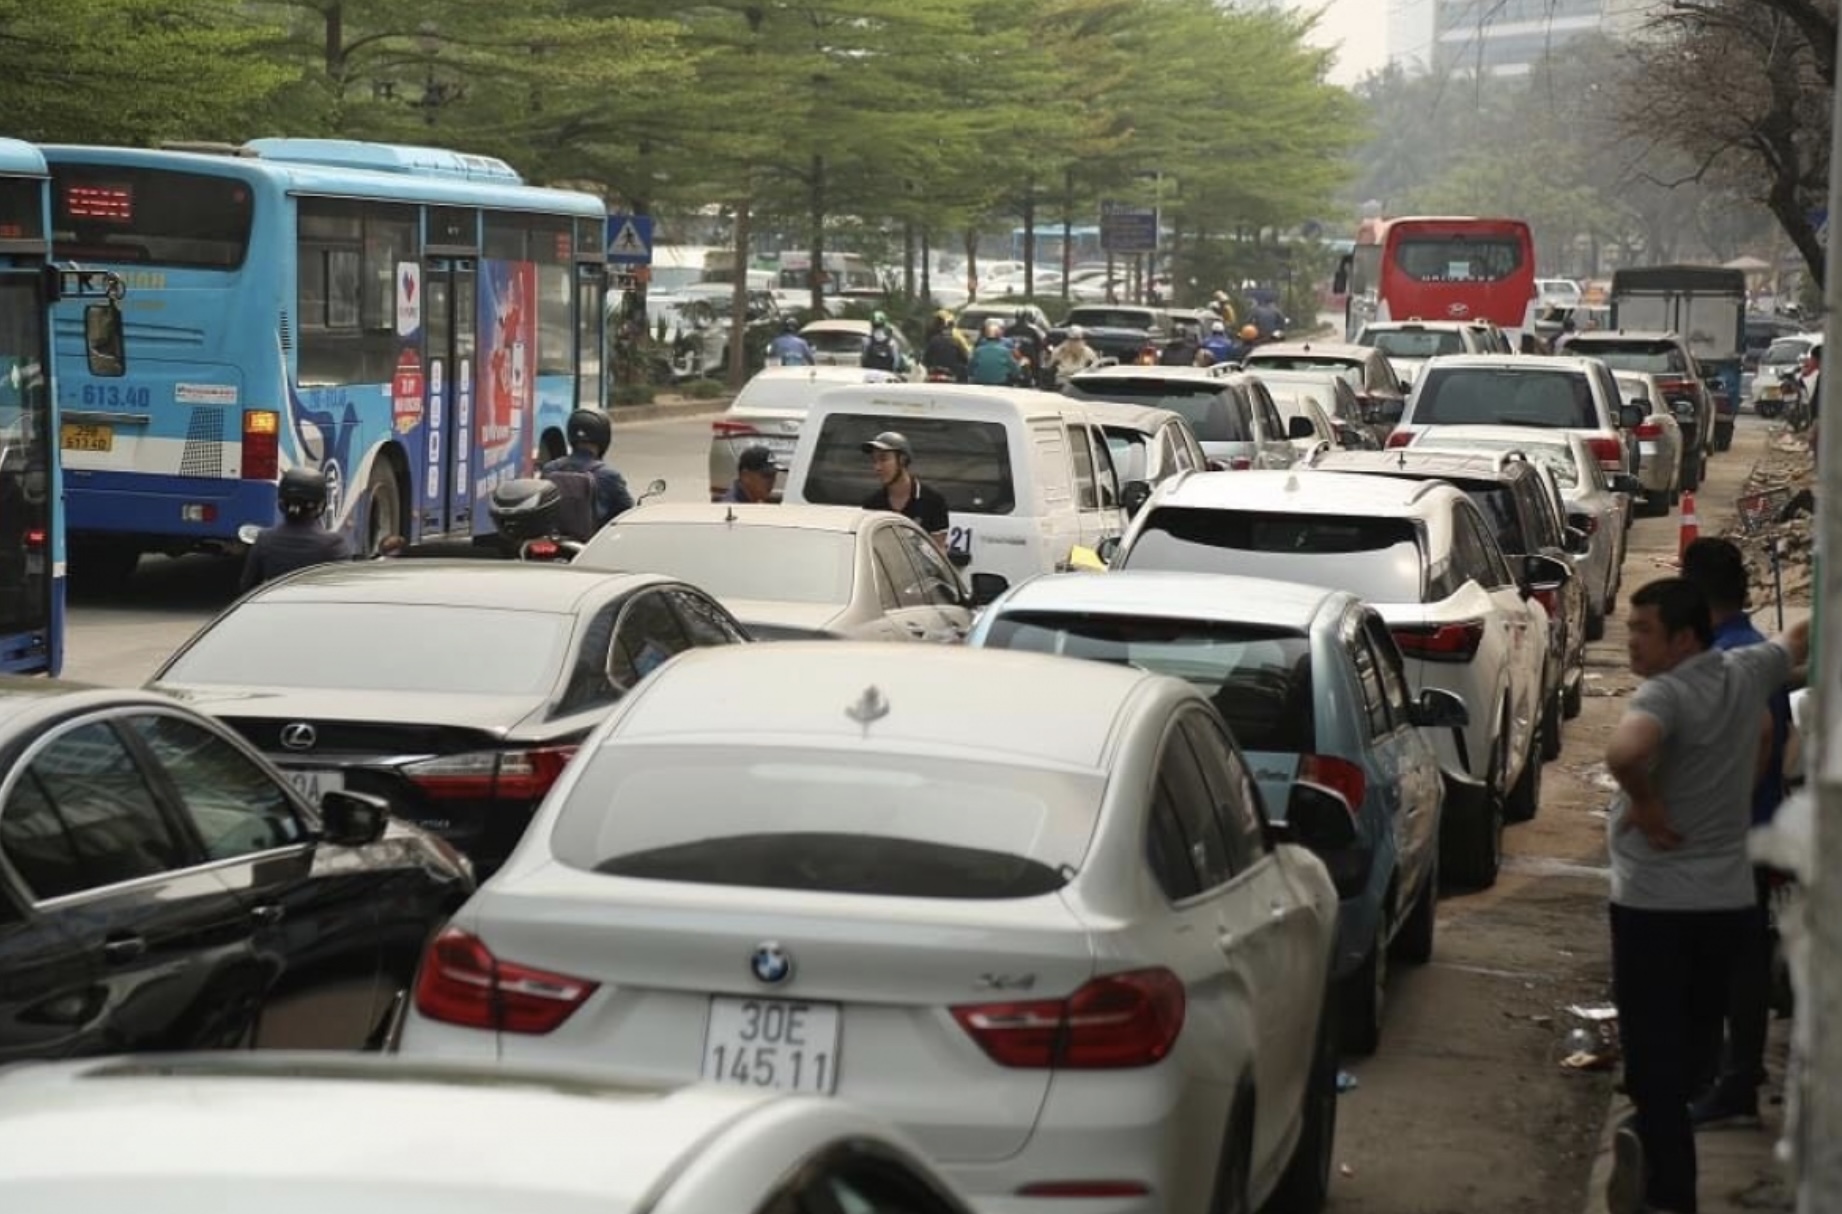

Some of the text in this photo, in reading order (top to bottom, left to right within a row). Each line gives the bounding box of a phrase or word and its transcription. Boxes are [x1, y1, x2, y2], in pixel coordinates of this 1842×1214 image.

[82, 384, 151, 408] 613.40
[739, 1001, 809, 1046] 30E
[713, 1045, 827, 1092] 145.11
